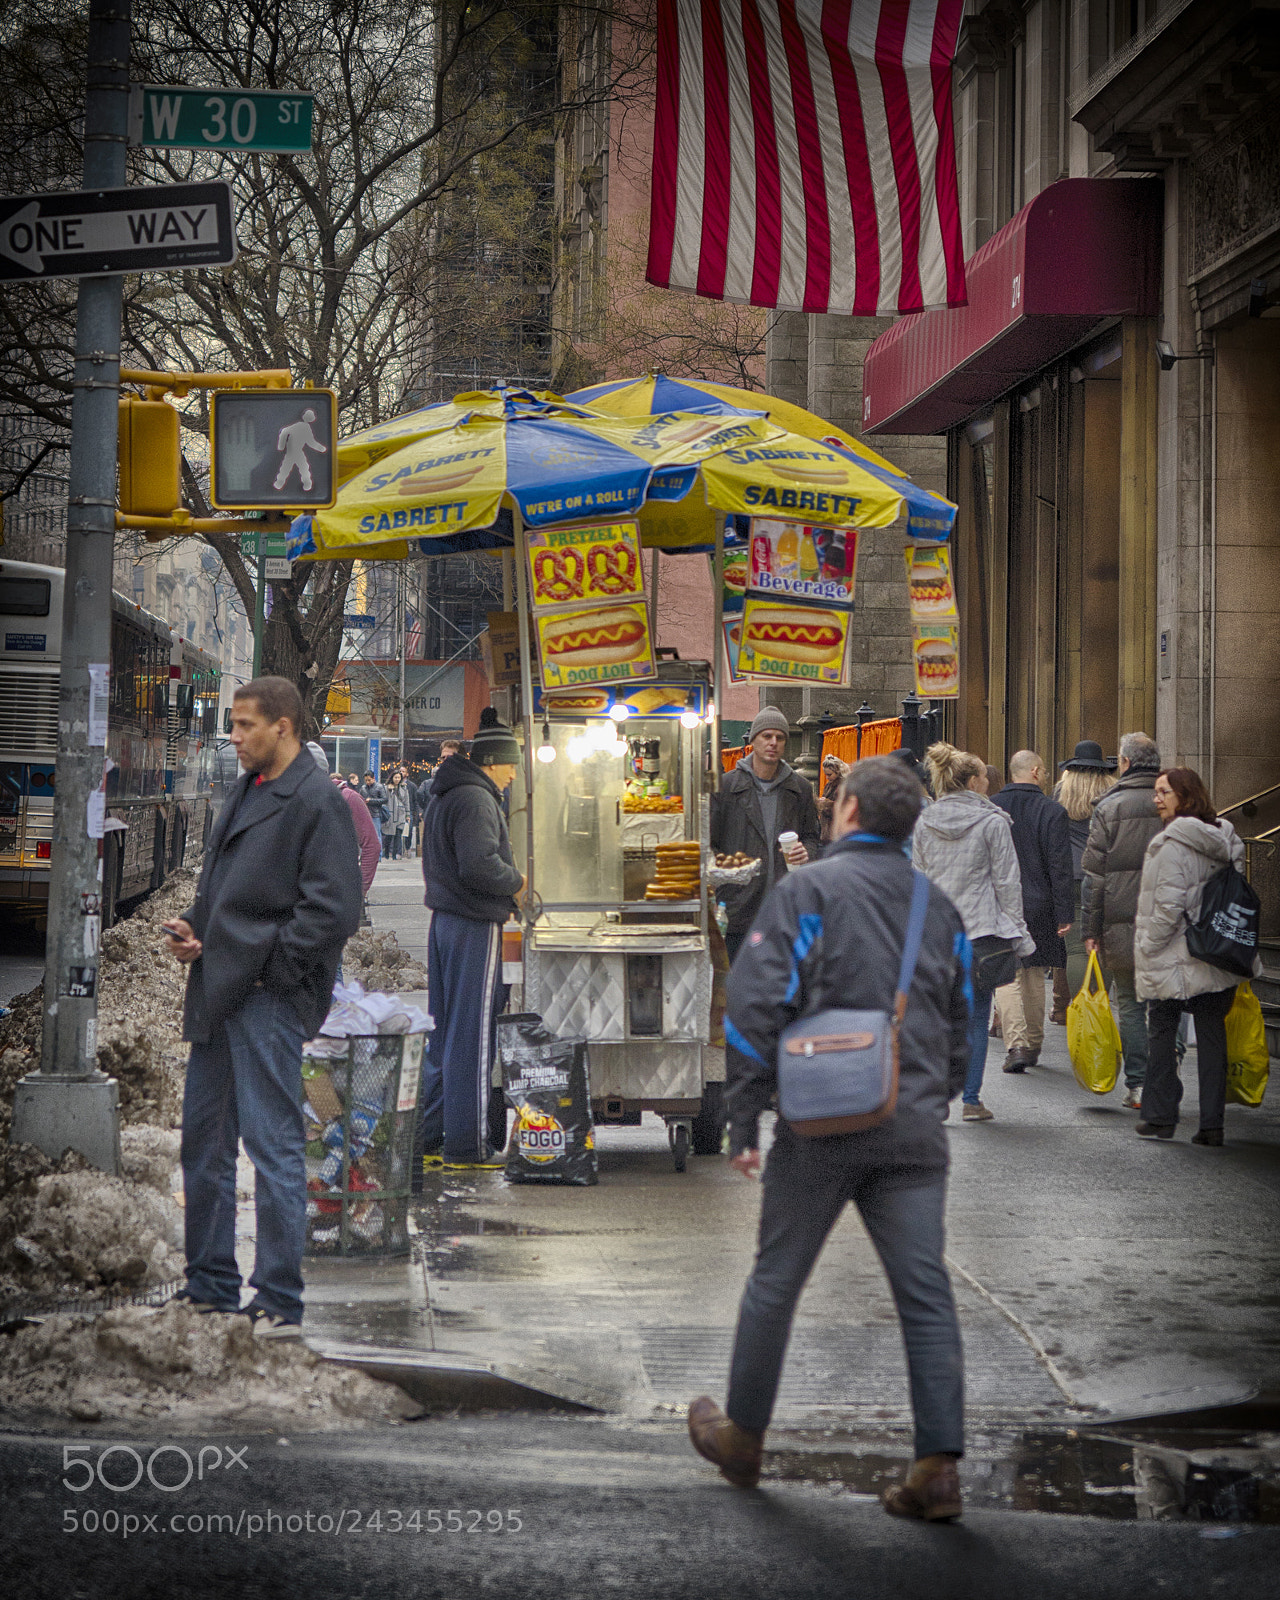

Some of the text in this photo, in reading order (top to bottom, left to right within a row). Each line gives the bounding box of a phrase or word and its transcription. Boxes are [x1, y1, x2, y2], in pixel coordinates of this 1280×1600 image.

[150, 95, 303, 144] W 30 ST
[8, 208, 208, 254] ONE WAY
[725, 449, 836, 465] SABRETT
[364, 448, 497, 492] SABRETT
[525, 499, 562, 516] WE'RE
[565, 496, 582, 509] ON
[585, 494, 594, 506] A
[596, 490, 624, 505] ROLL
[743, 486, 862, 516] SABRETT
[359, 501, 468, 534] SABRETT
[548, 527, 617, 547] PRETZEL
[759, 571, 848, 599] Beverage
[567, 663, 631, 683] HOT DOG
[760, 658, 820, 678] HOT DOG
[429, 697, 441, 710] CO
[509, 1073, 569, 1091] LUMP CHARCOAL
[520, 1066, 557, 1079] PREMIUM
[520, 1130, 562, 1147] FOGO
